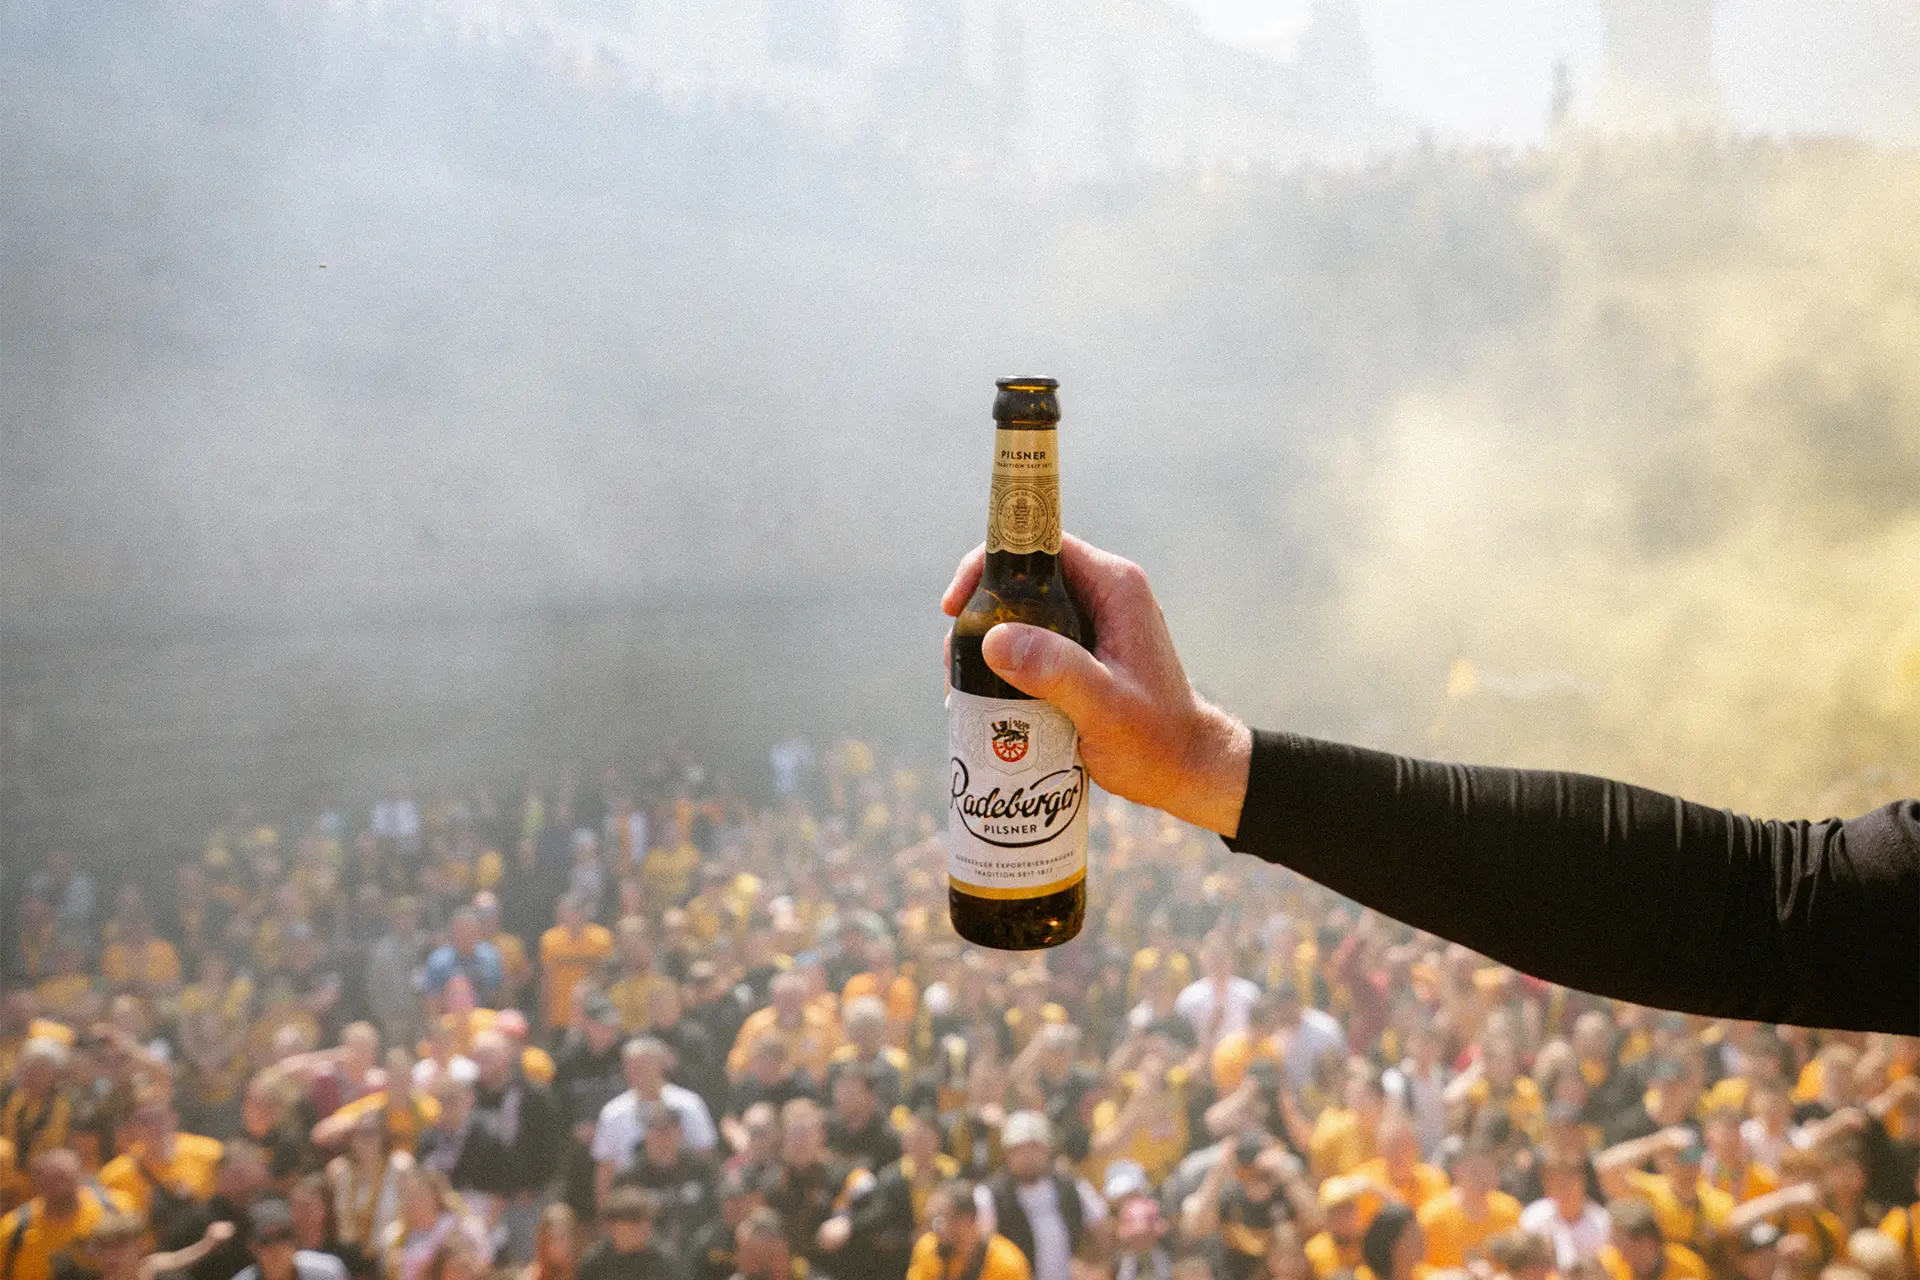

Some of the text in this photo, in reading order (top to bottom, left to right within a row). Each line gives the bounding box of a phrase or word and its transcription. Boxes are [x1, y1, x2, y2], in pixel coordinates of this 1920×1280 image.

[1001, 450, 1046, 460] PILSNER
[950, 756, 1079, 828] Radeberger
[983, 824, 1037, 834] PILSNER
